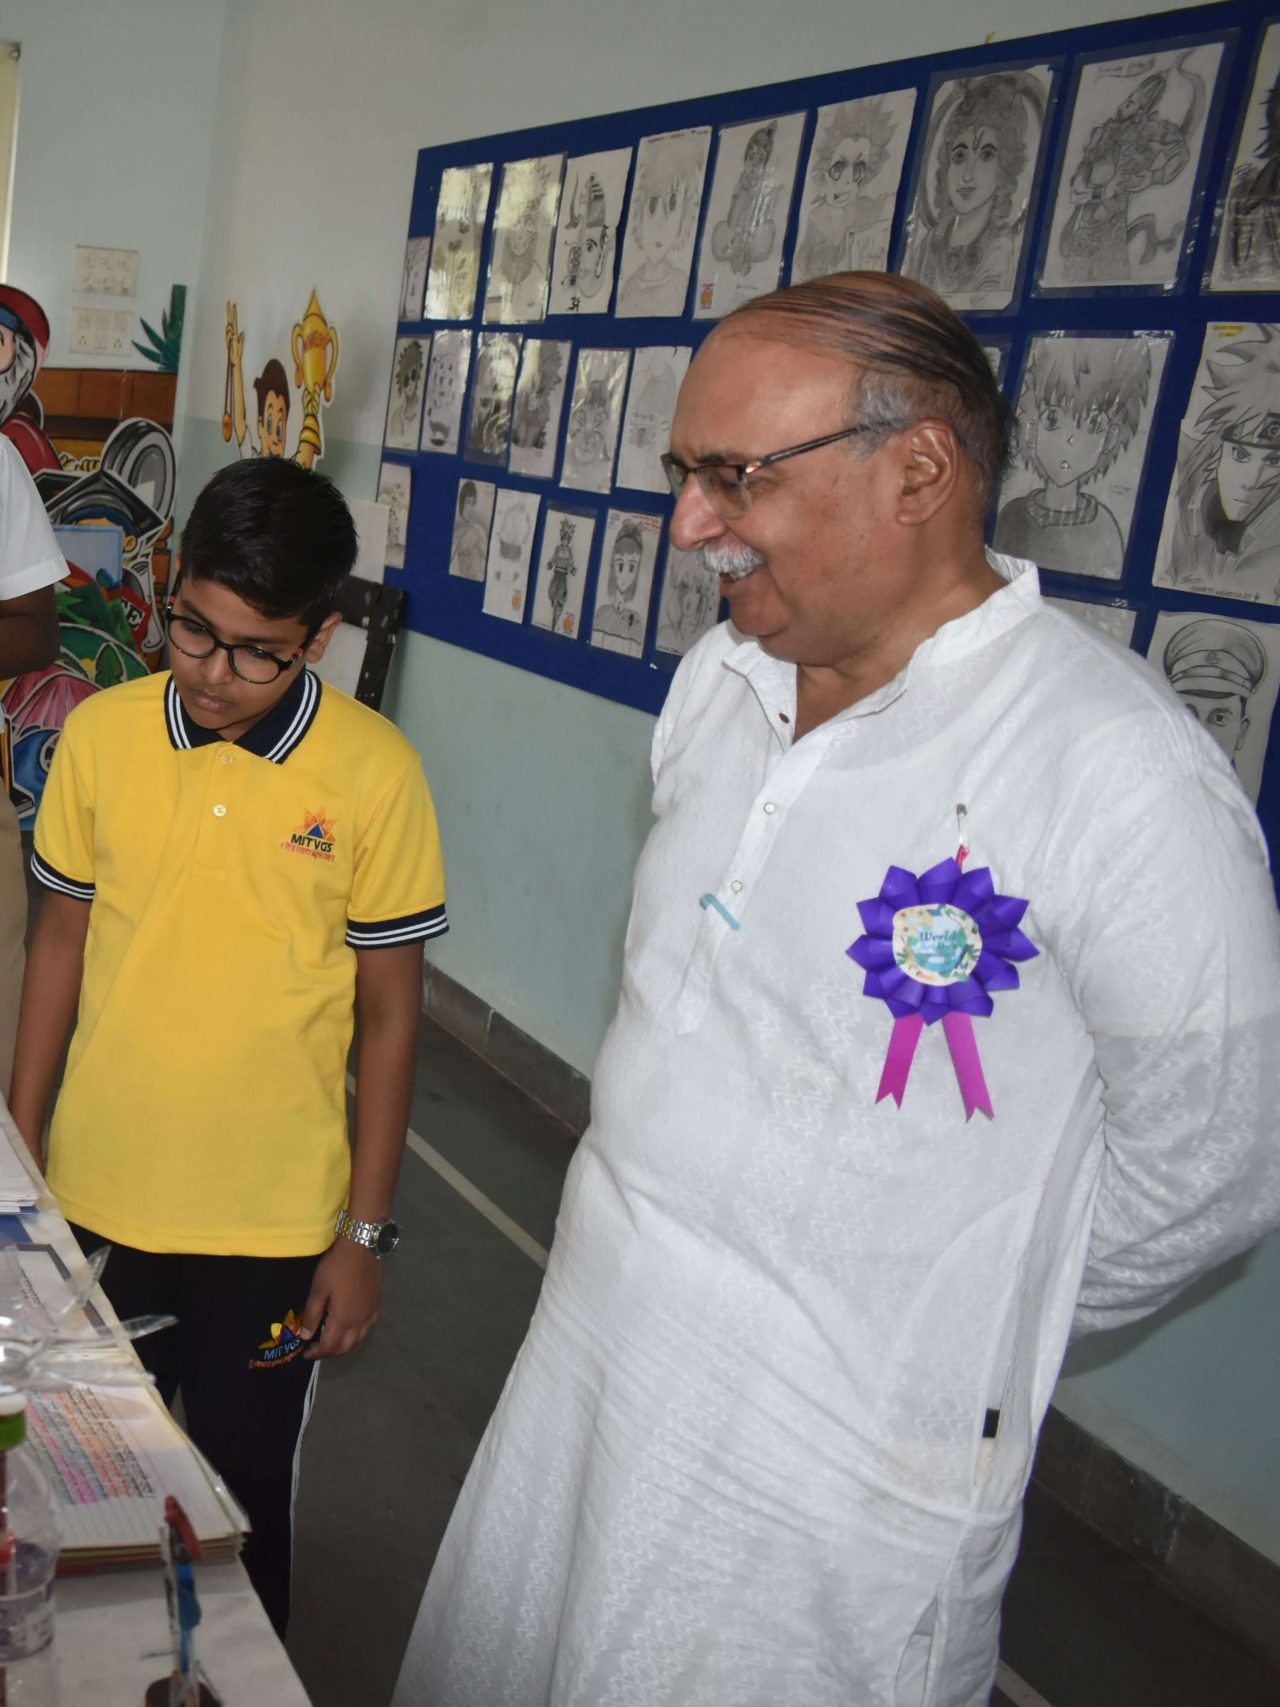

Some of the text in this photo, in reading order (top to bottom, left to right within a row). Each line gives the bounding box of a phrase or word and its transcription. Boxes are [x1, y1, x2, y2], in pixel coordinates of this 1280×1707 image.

[291, 833, 314, 847] MIT
[314, 840, 334, 853] VGS
[920, 930, 957, 942] World
[263, 1346, 283, 1360] MIT
